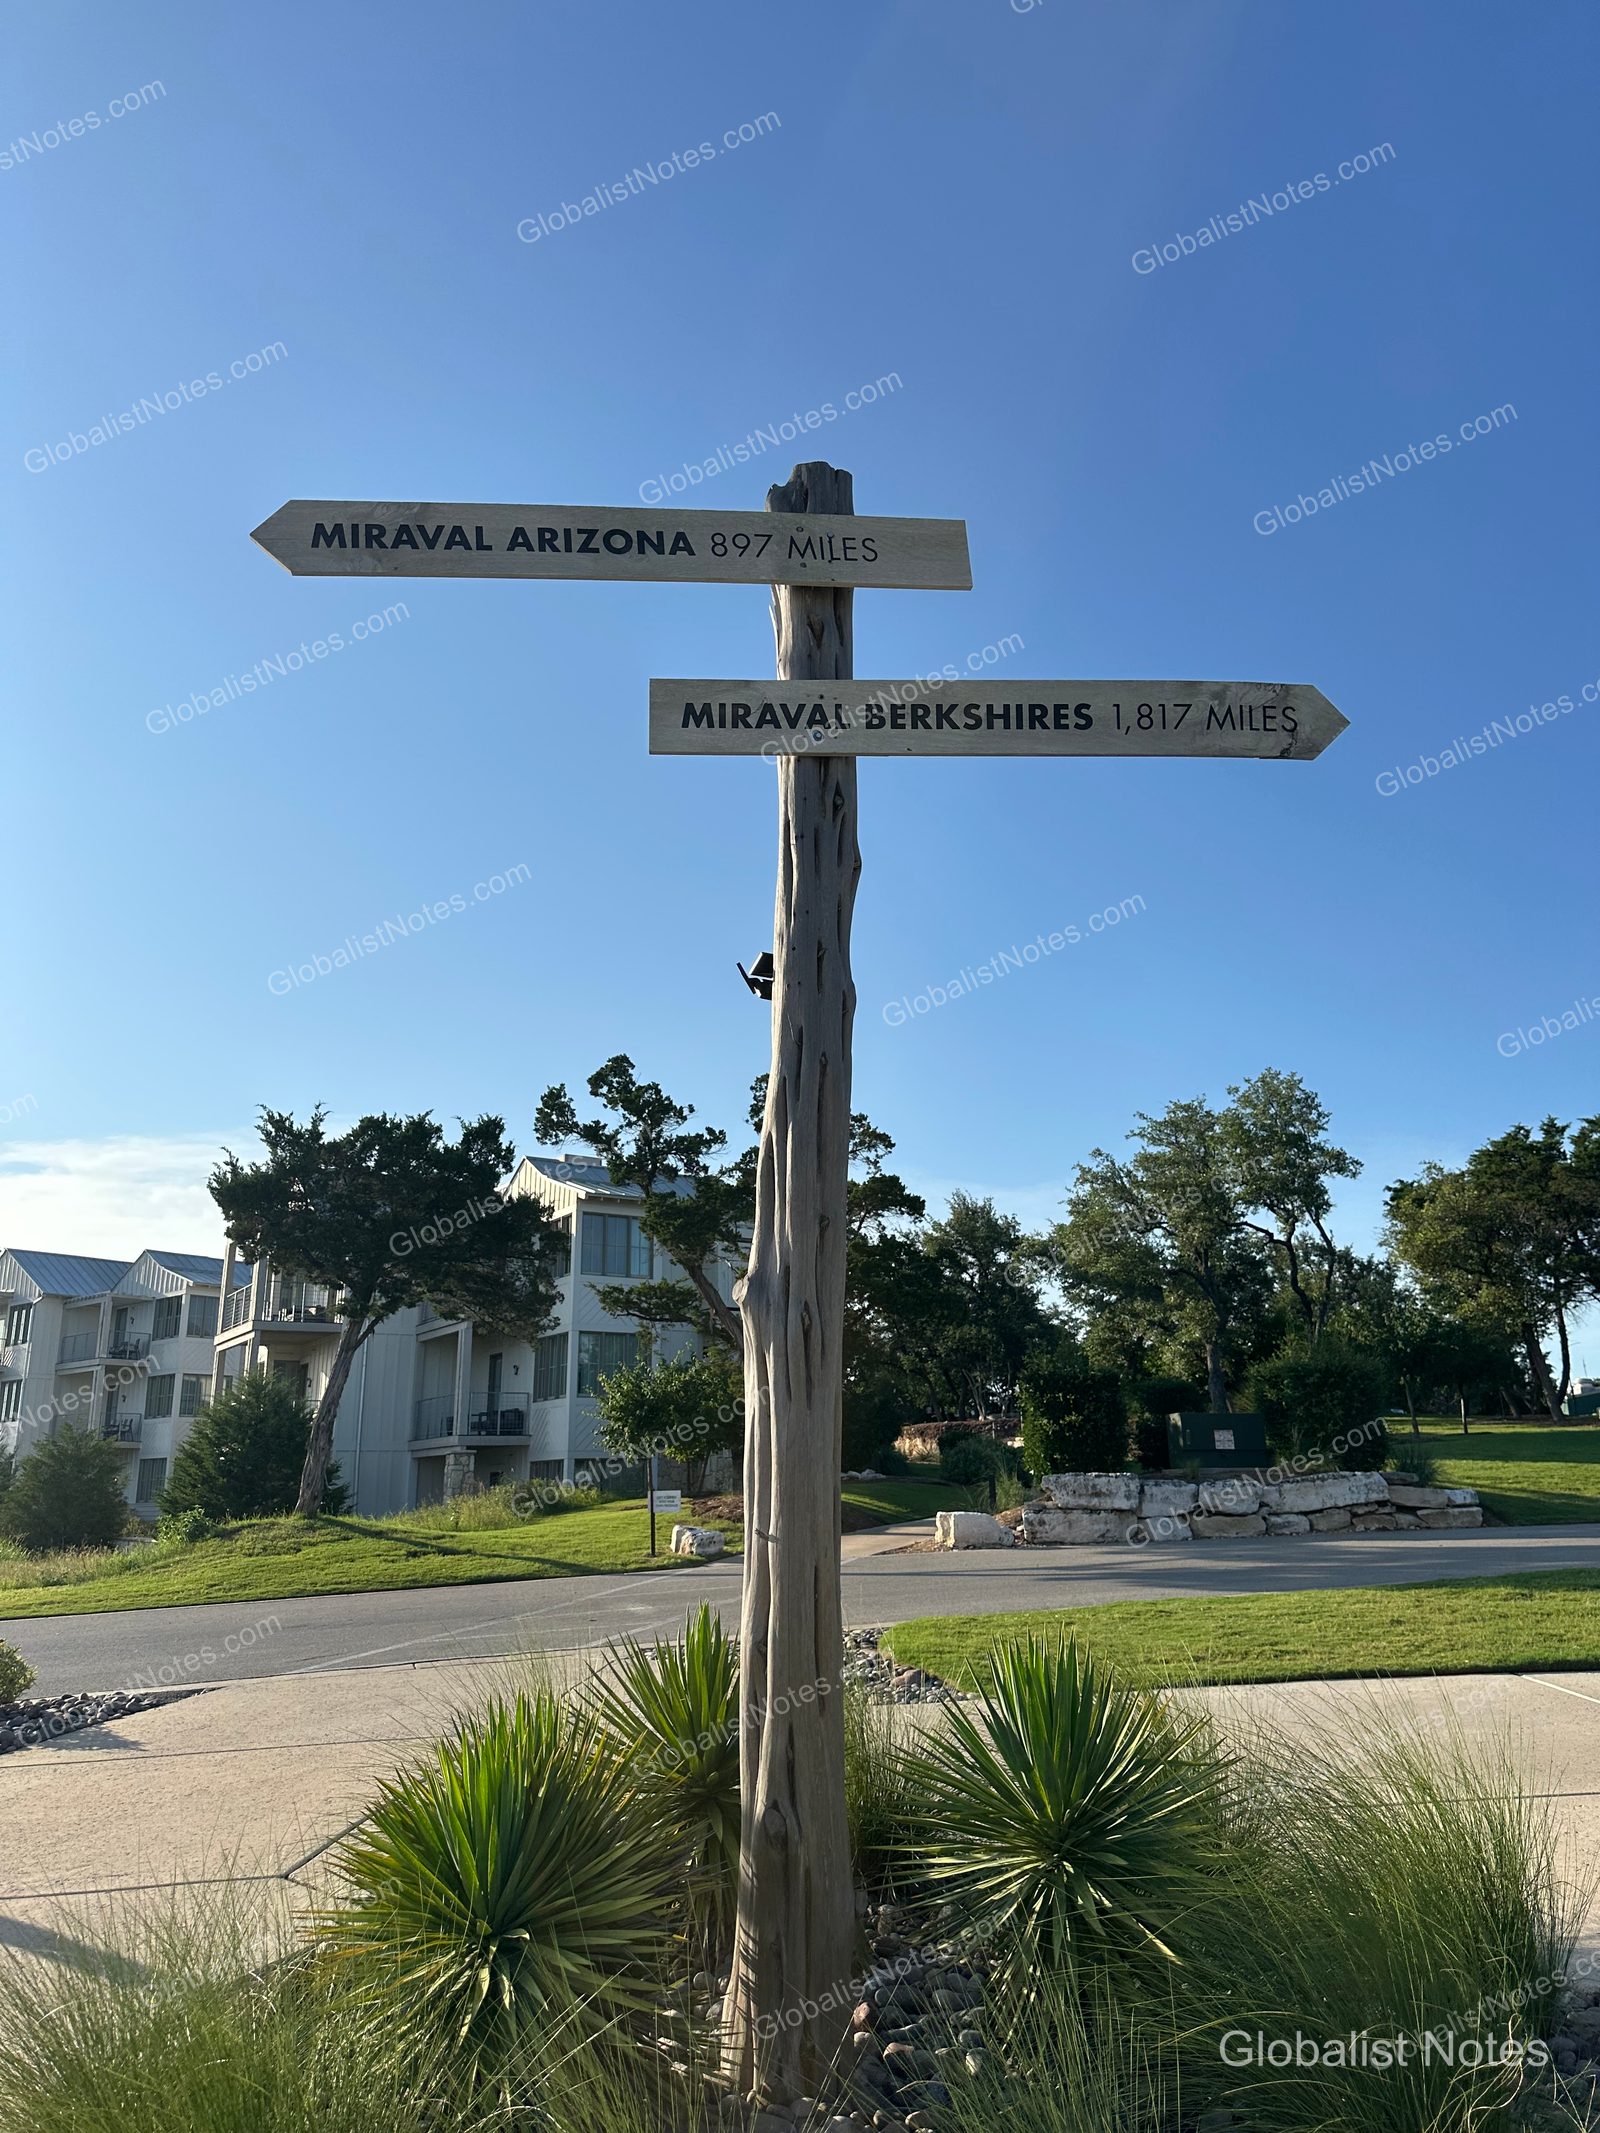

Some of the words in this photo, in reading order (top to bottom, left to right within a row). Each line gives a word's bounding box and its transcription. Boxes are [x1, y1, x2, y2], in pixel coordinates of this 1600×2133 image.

[310, 522, 493, 551] MIRAVAL
[506, 527, 696, 557] ARIZONA
[710, 532, 773, 558] 897
[788, 535, 879, 562] MILES
[681, 702, 850, 730] MIRAVAL
[864, 702, 1093, 731] BERKSHIRES
[1113, 703, 1193, 735] 1,817
[1206, 704, 1298, 732] MILES
